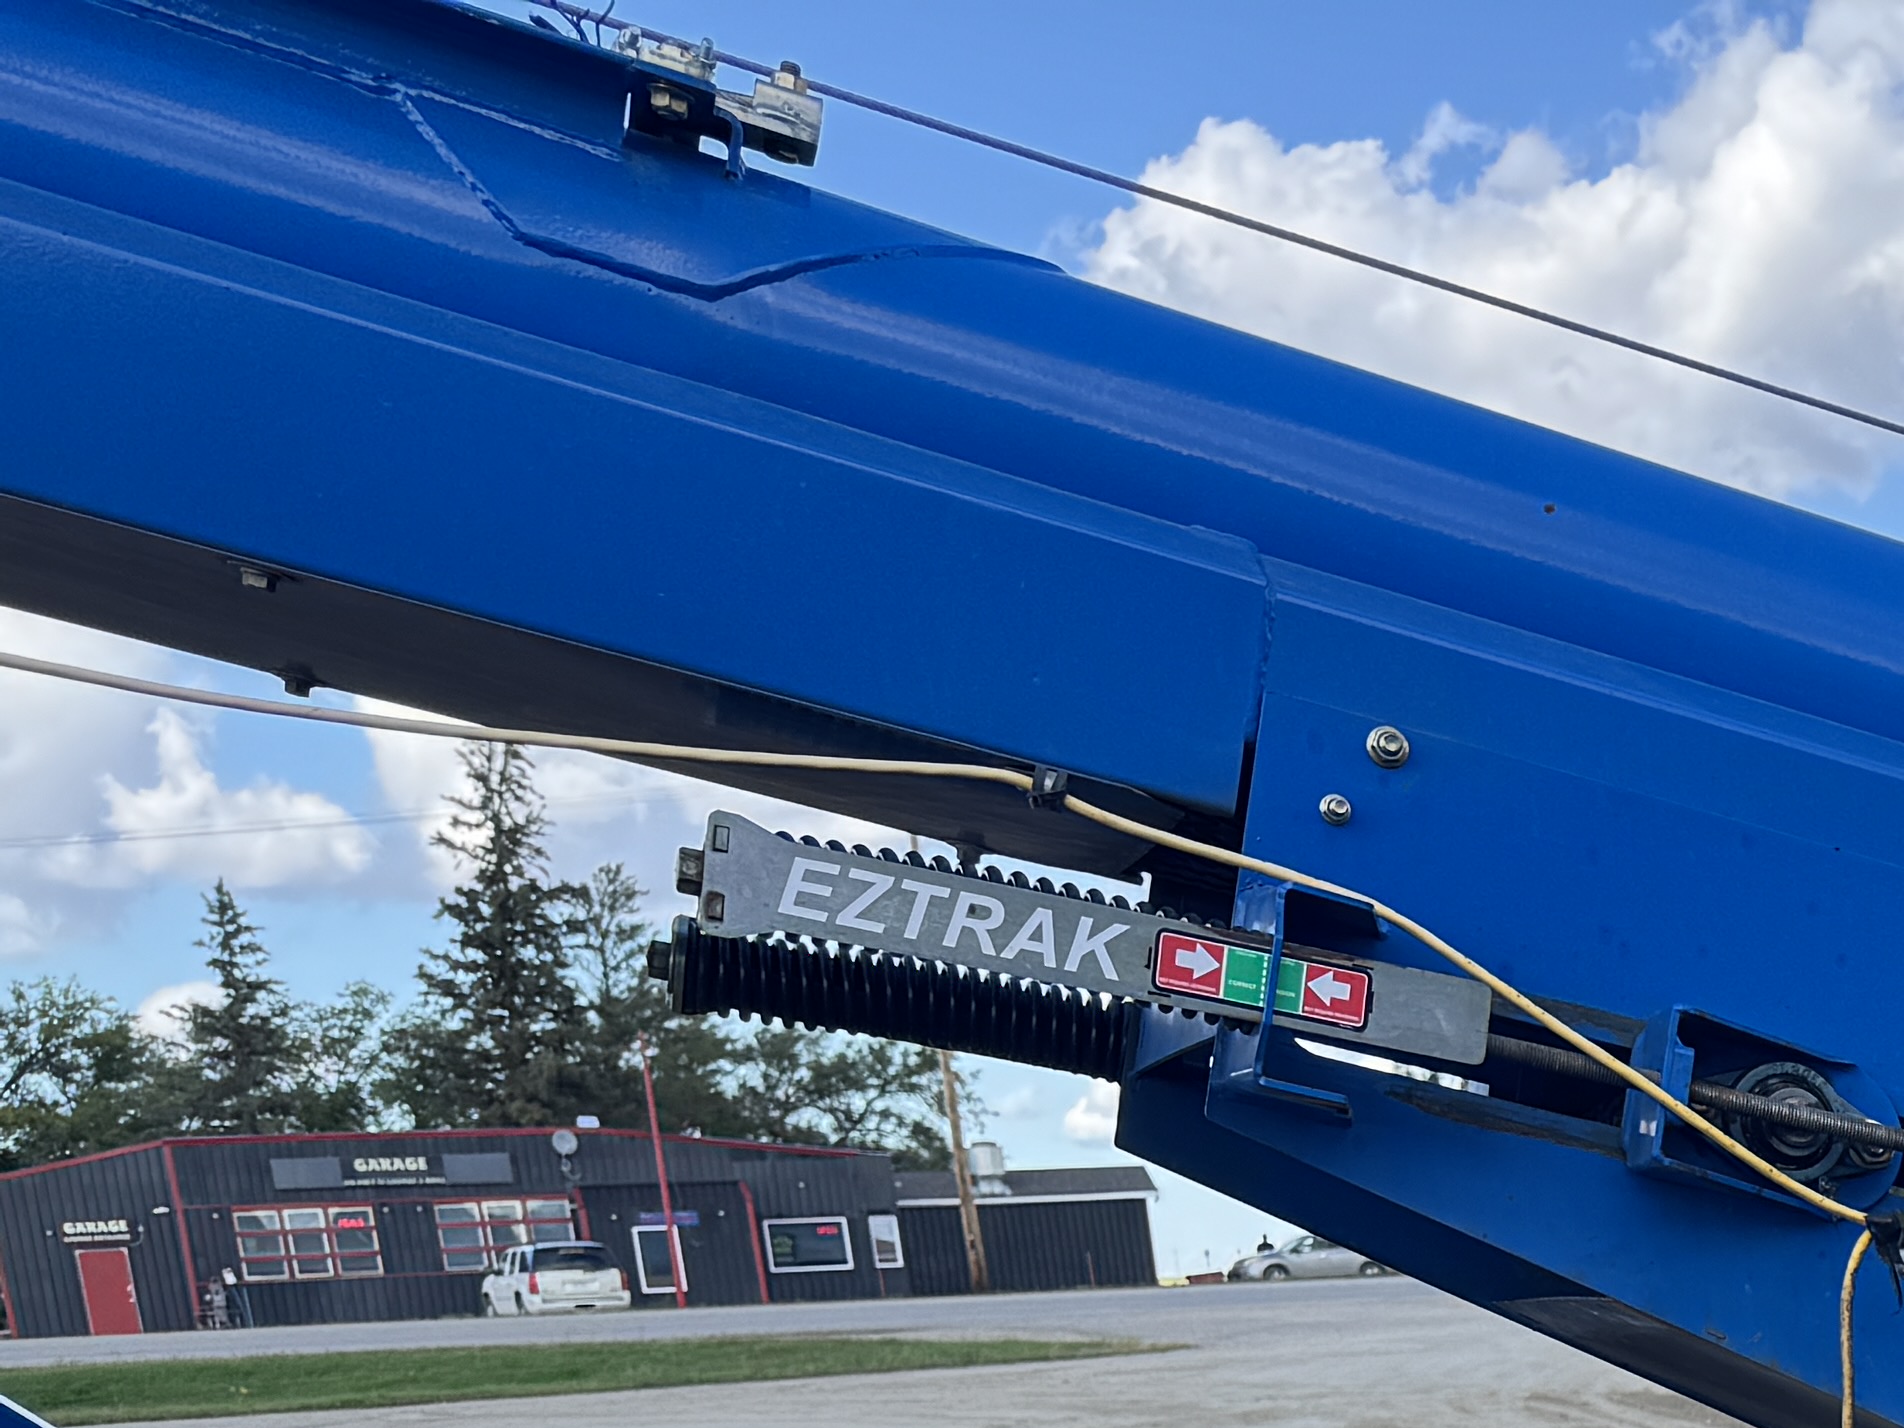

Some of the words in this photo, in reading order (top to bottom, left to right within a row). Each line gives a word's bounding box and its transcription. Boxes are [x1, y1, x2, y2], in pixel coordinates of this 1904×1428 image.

[778, 857, 1131, 982] EZTRAK
[353, 1156, 428, 1172] GARAGE
[63, 1219, 128, 1234] GARAGE
